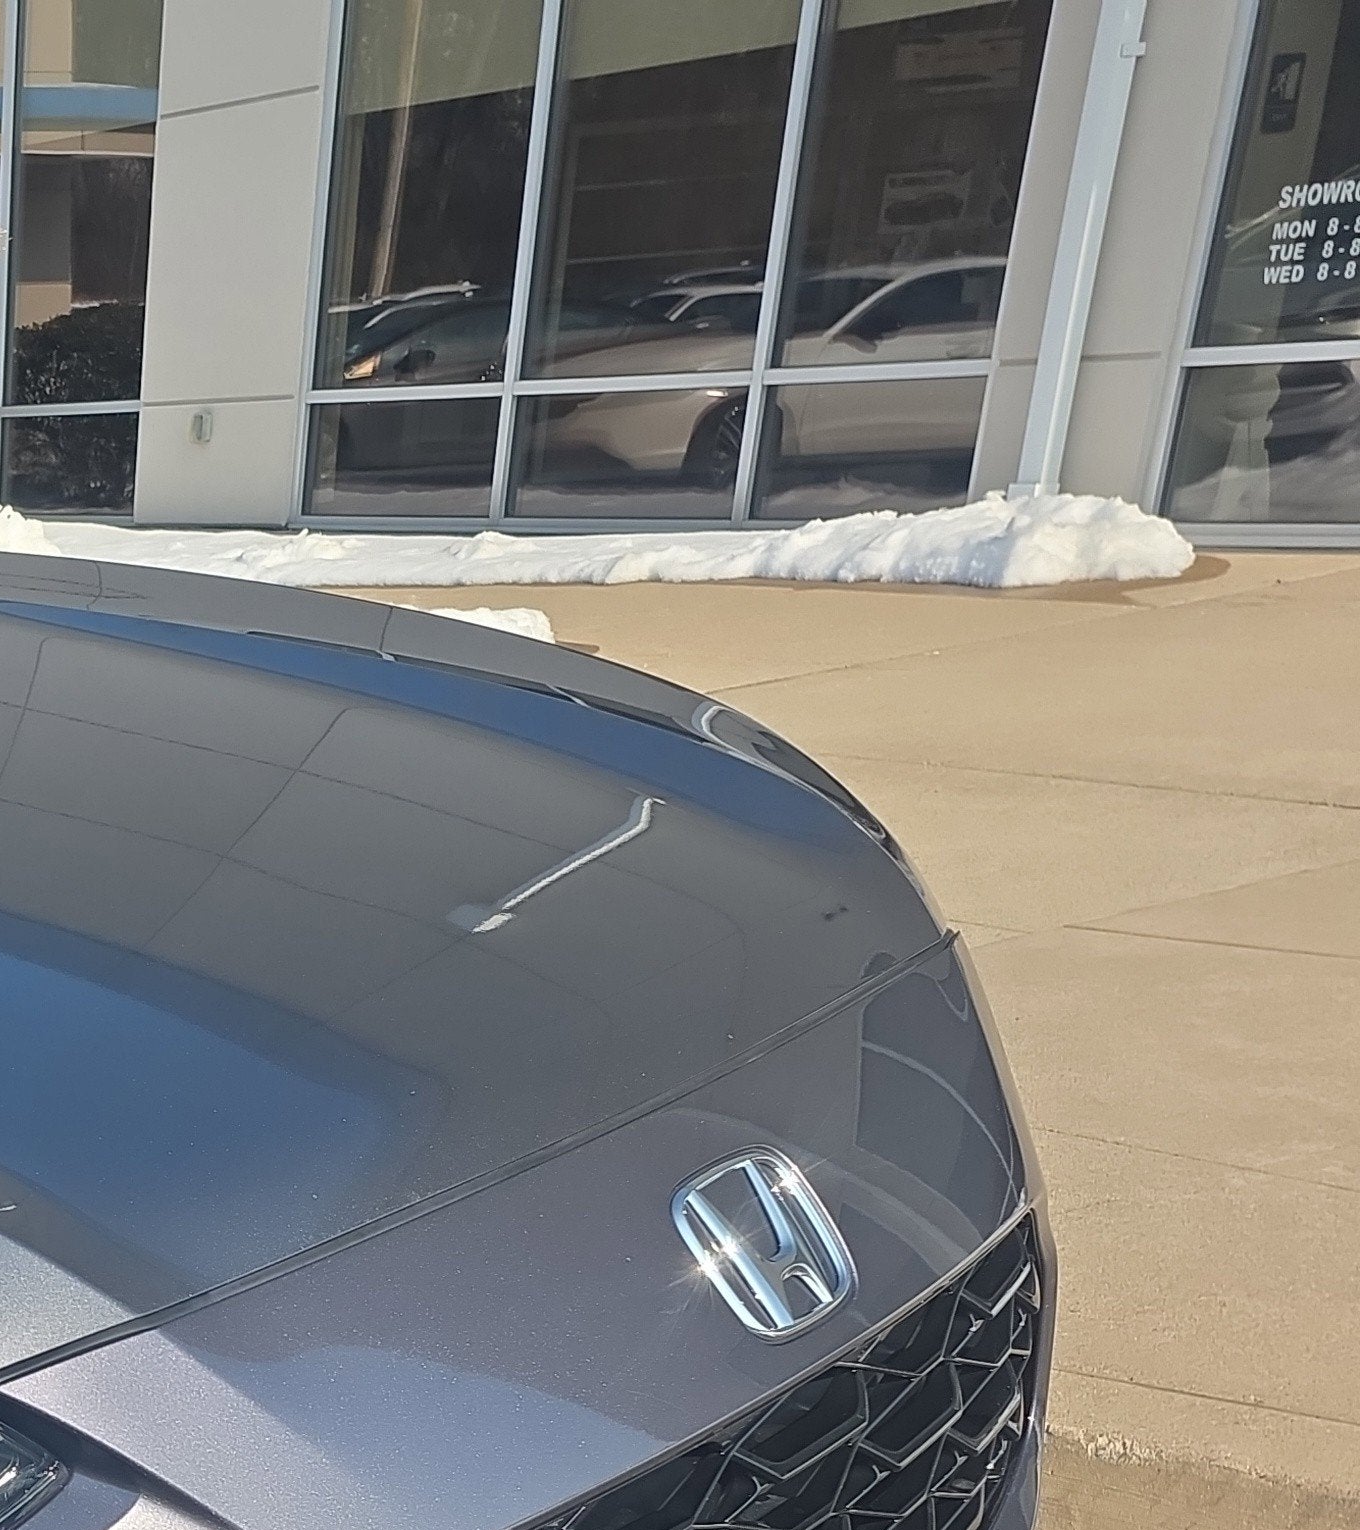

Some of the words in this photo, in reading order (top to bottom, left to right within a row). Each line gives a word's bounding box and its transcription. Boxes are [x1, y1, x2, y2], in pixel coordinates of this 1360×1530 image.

[1272, 219, 1316, 240] MON
[1269, 242, 1306, 262] TUE
[1263, 264, 1305, 285] WED
